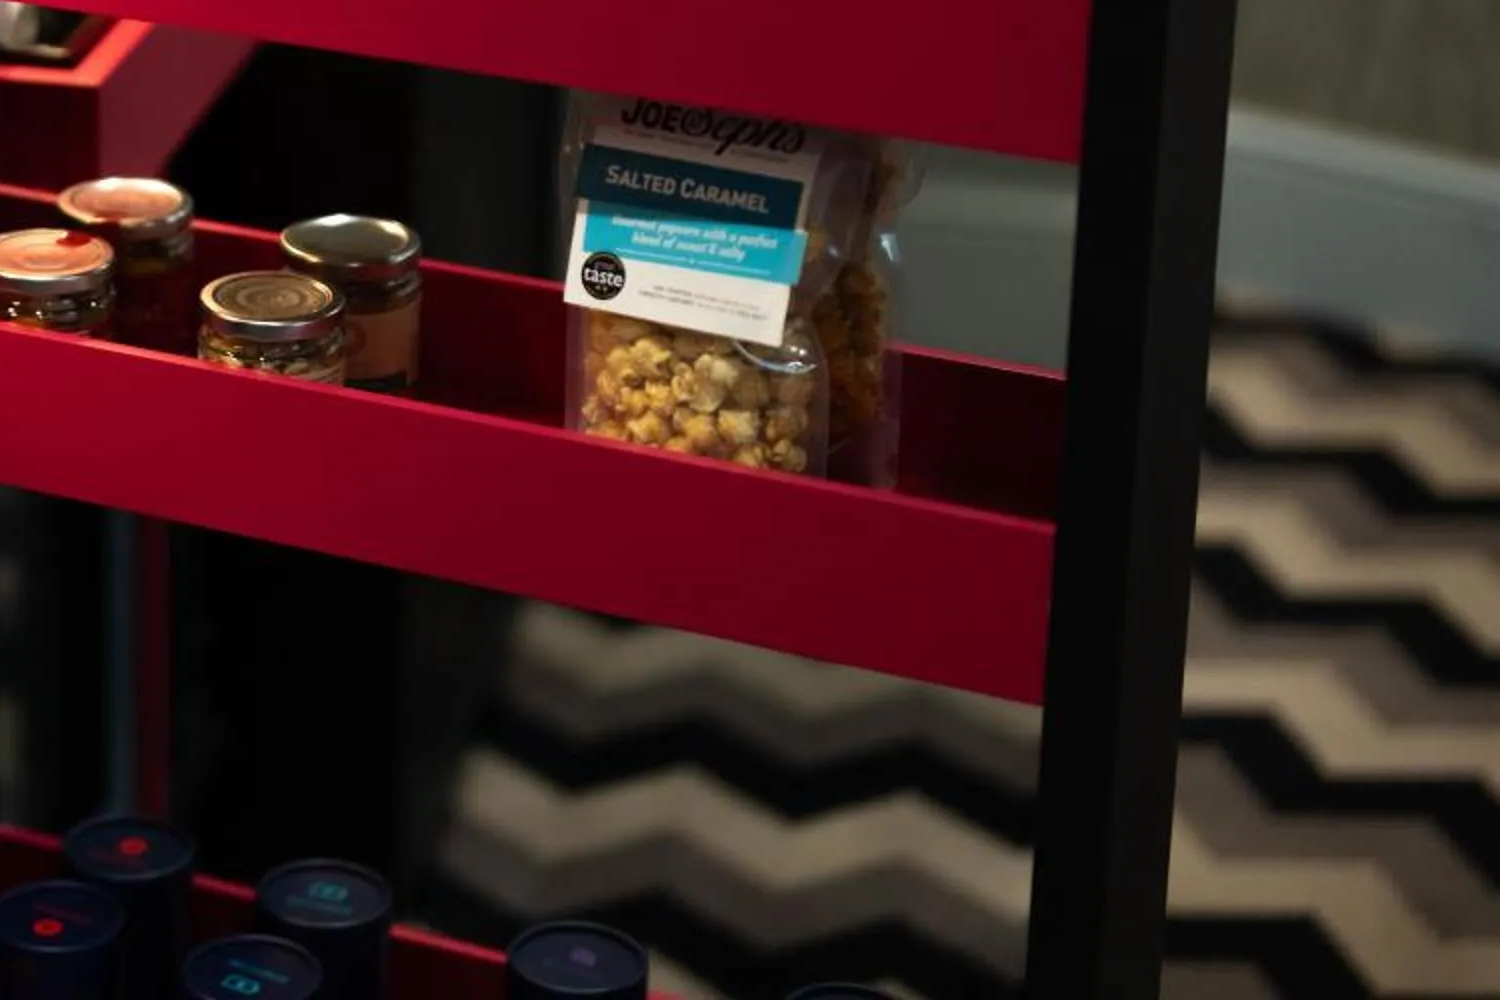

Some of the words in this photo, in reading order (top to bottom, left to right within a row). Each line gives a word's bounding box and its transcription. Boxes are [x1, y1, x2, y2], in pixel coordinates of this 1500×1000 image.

[605, 164, 676, 195] SALTED
[680, 178, 771, 214] CARAMEL
[583, 266, 624, 288] taste
